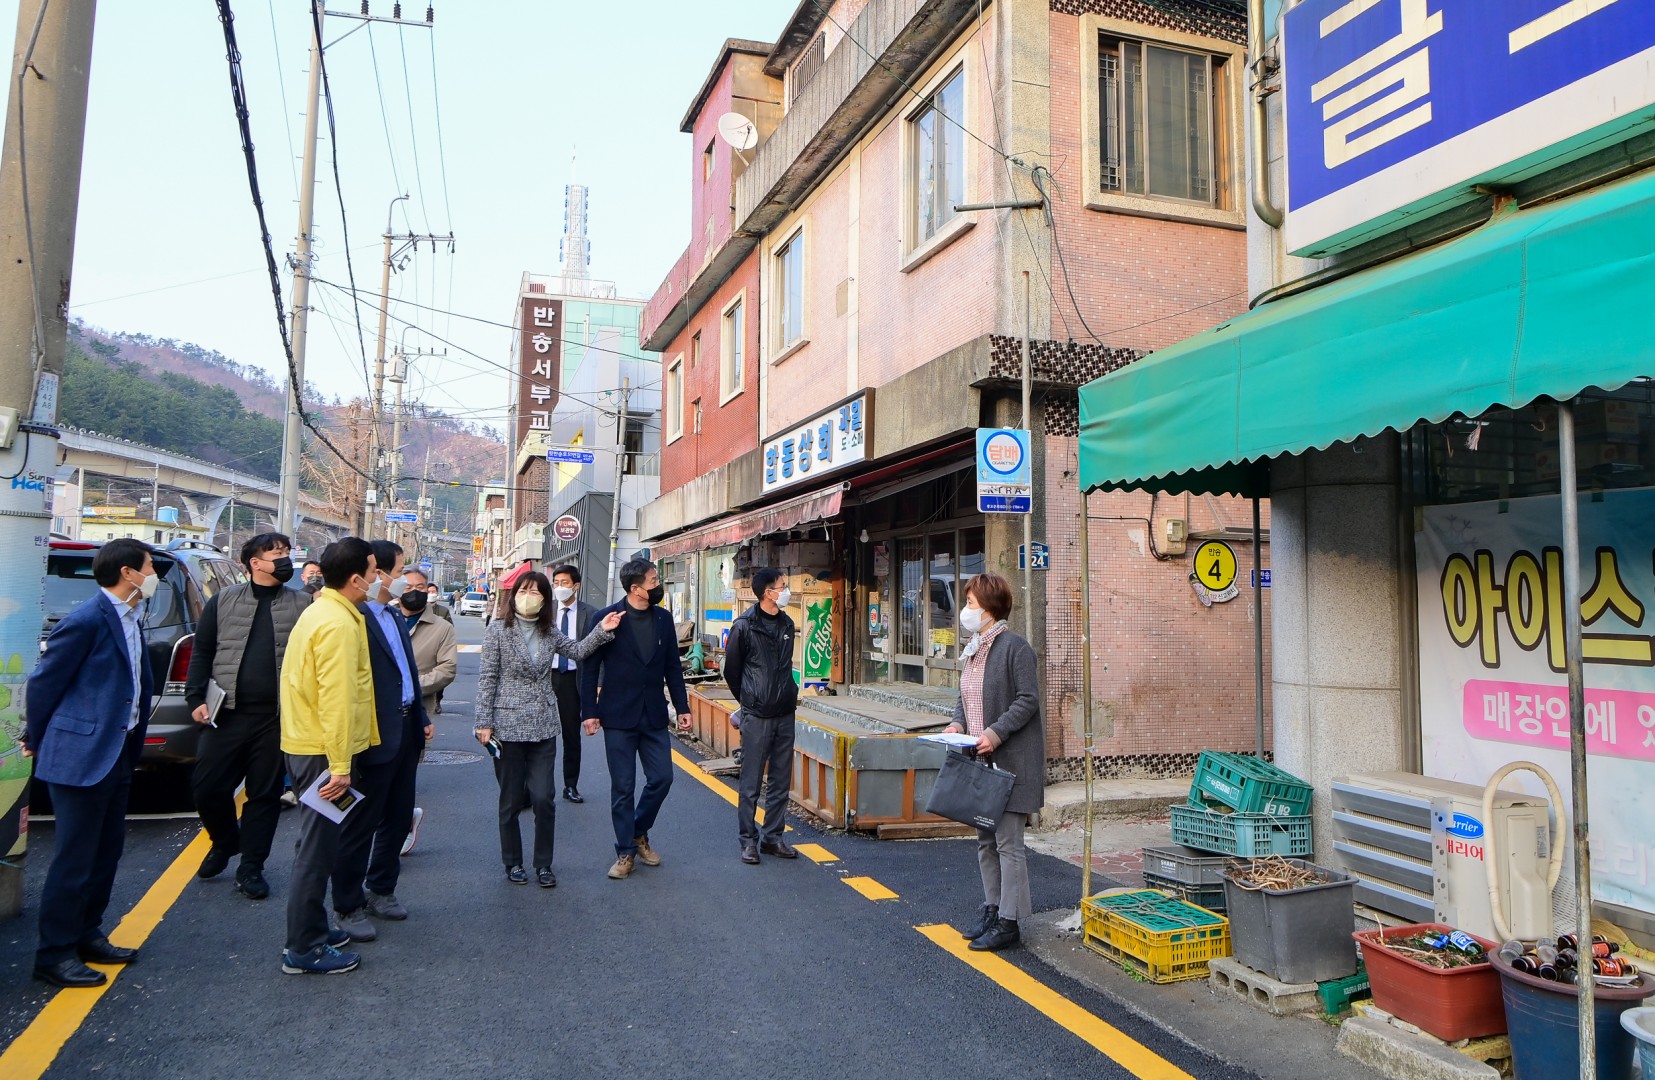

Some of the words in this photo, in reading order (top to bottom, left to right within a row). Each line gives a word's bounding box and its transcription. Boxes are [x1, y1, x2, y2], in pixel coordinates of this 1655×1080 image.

[839, 399, 863, 434] 과일
[989, 445, 1019, 461] 담배
[1208, 548, 1221, 556] 반송
[1031, 556, 1045, 567] 24
[1208, 559, 1221, 581] 4
